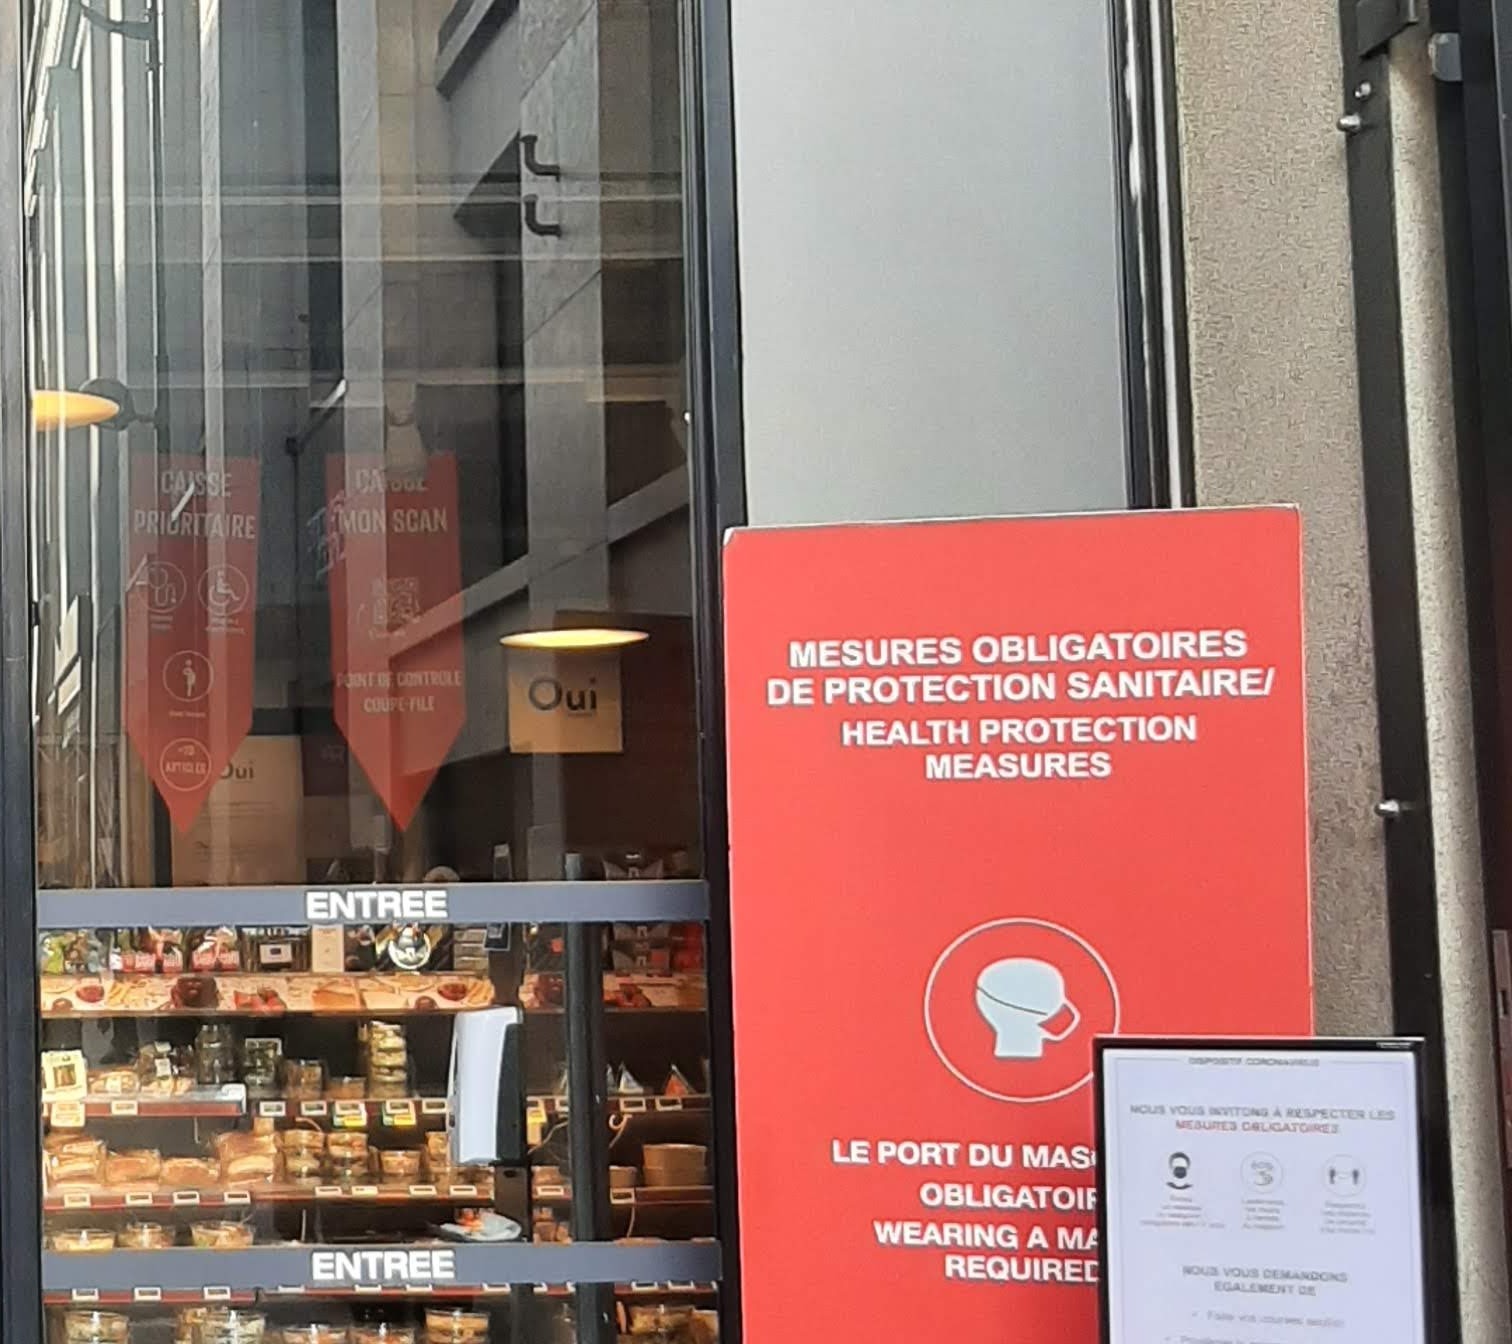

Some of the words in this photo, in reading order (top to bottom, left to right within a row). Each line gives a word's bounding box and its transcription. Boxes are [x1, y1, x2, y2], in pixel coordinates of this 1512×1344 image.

[159, 469, 233, 498] CAISSE
[133, 510, 257, 541] PRIORITAIRE
[339, 509, 386, 534] MON
[391, 508, 449, 534] SCAN
[789, 638, 963, 668] MESURES
[972, 629, 1248, 665] OBLIGATOIRES
[527, 676, 598, 712] Oui
[767, 677, 814, 706] DE
[824, 672, 1057, 705] PROTECTION
[1066, 666, 1275, 699] SANITAIRE/
[842, 719, 971, 747] HEALTH
[979, 715, 1198, 745] PROTECTION
[925, 752, 1113, 780] MEASURES
[306, 890, 449, 920] ENTREE
[1130, 1104, 1165, 1115] NOUS
[1169, 1105, 1206, 1116] VOUS
[1208, 1106, 1269, 1118] INVITONS
[1287, 1107, 1365, 1121] RESPECTER
[1368, 1109, 1395, 1121] LES
[1175, 1120, 1238, 1132] MESURES
[1241, 1121, 1340, 1135] OBLIGATOIRES
[831, 1139, 870, 1164] LE
[877, 1141, 960, 1166] PORT
[968, 1143, 1013, 1168] DU
[873, 1220, 1018, 1249] WEARING
[1027, 1225, 1049, 1249] A
[311, 1250, 456, 1281] ENTREE
[944, 1254, 1100, 1283] REQUIRED
[1182, 1265, 1220, 1277] NOUS
[1223, 1267, 1260, 1279] VOUS
[1263, 1268, 1349, 1283] DEMANDONS
[1298, 1284, 1317, 1296] DE
